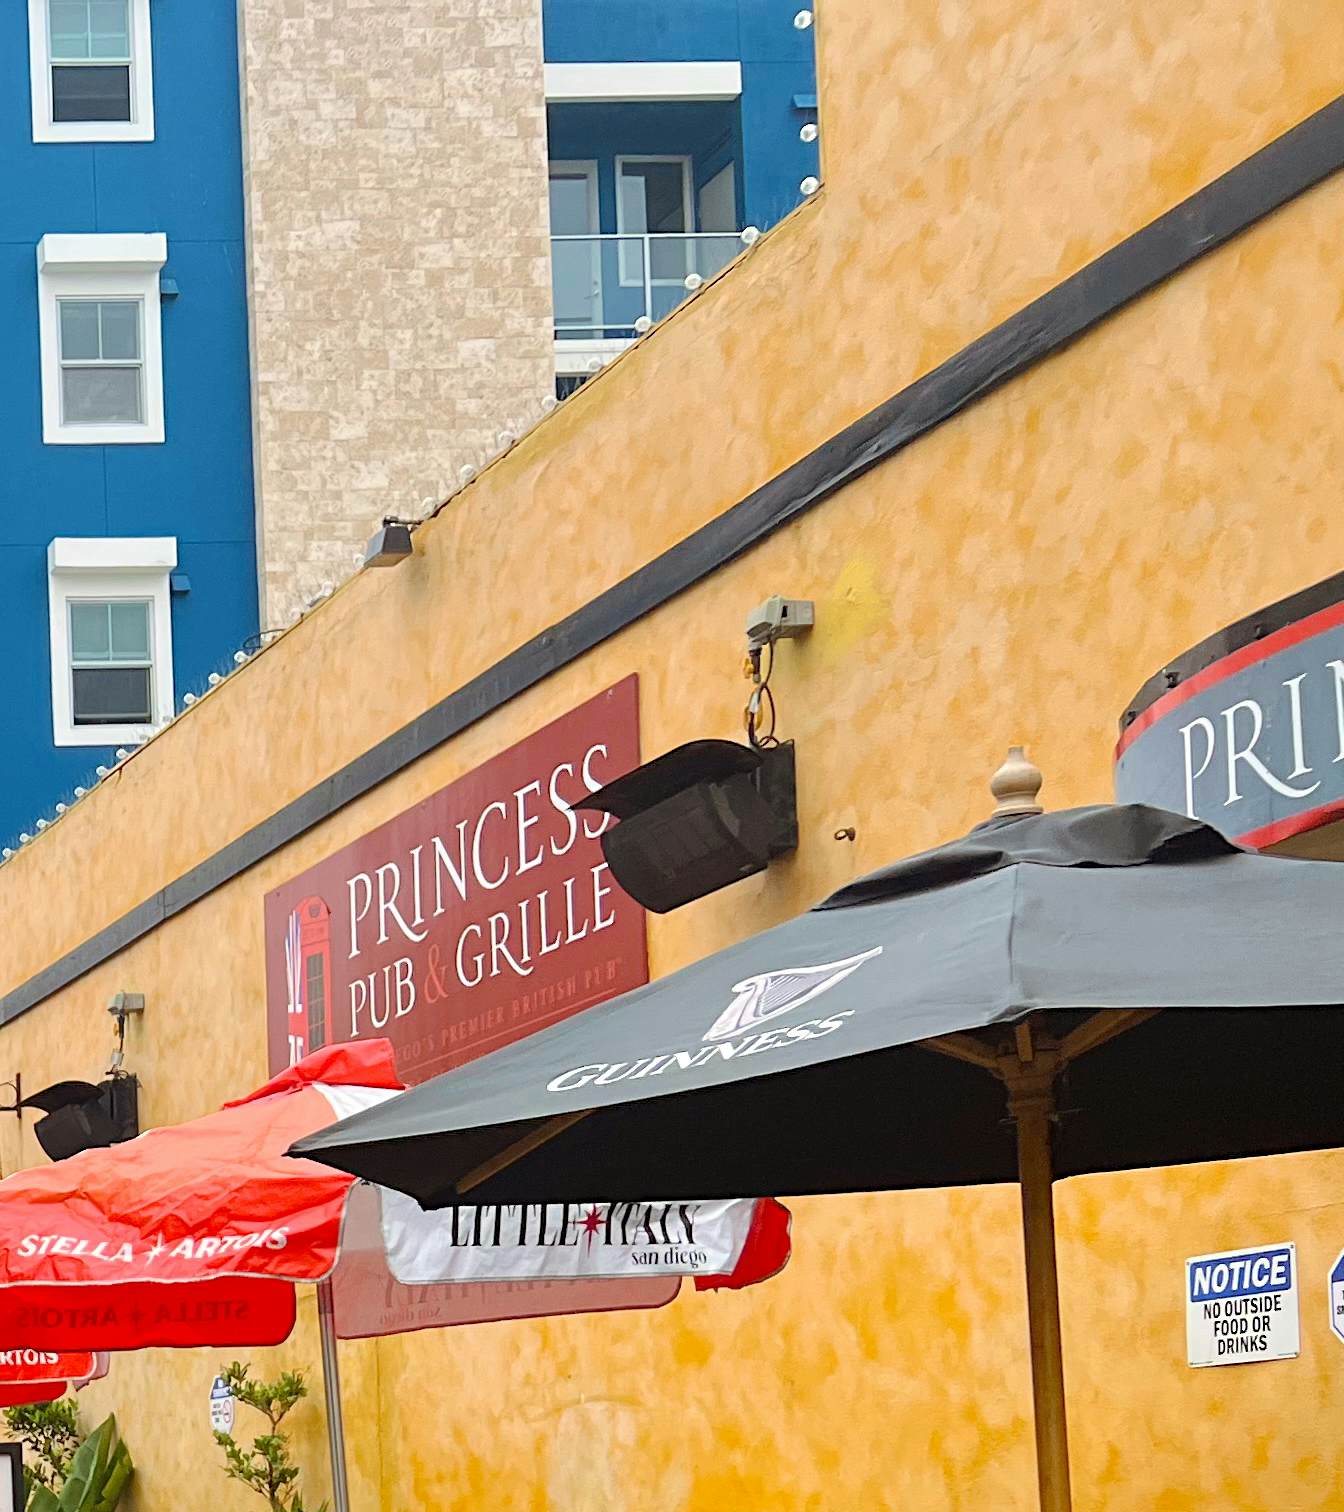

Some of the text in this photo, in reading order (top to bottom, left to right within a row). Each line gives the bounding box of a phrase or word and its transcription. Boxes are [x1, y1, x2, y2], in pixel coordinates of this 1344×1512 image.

[346, 743, 609, 961] PRINCESS
[348, 862, 616, 1038] PUB & GRILLE
[441, 1006, 505, 1047] PREMIER
[512, 978, 577, 1019] BRITISH
[585, 959, 617, 989] PUB
[545, 1009, 856, 1092] GUINNESS
[16, 1226, 291, 1263] STELLA ARTOIS
[450, 1201, 702, 1248] LITTLE ITALY
[631, 1247, 707, 1270] san diego
[1193, 1254, 1289, 1297] NOTICE
[1204, 1294, 1282, 1319] NO OUTSIDE
[1214, 1315, 1271, 1337] FOOD OR
[1217, 1334, 1268, 1356] DRINKS
